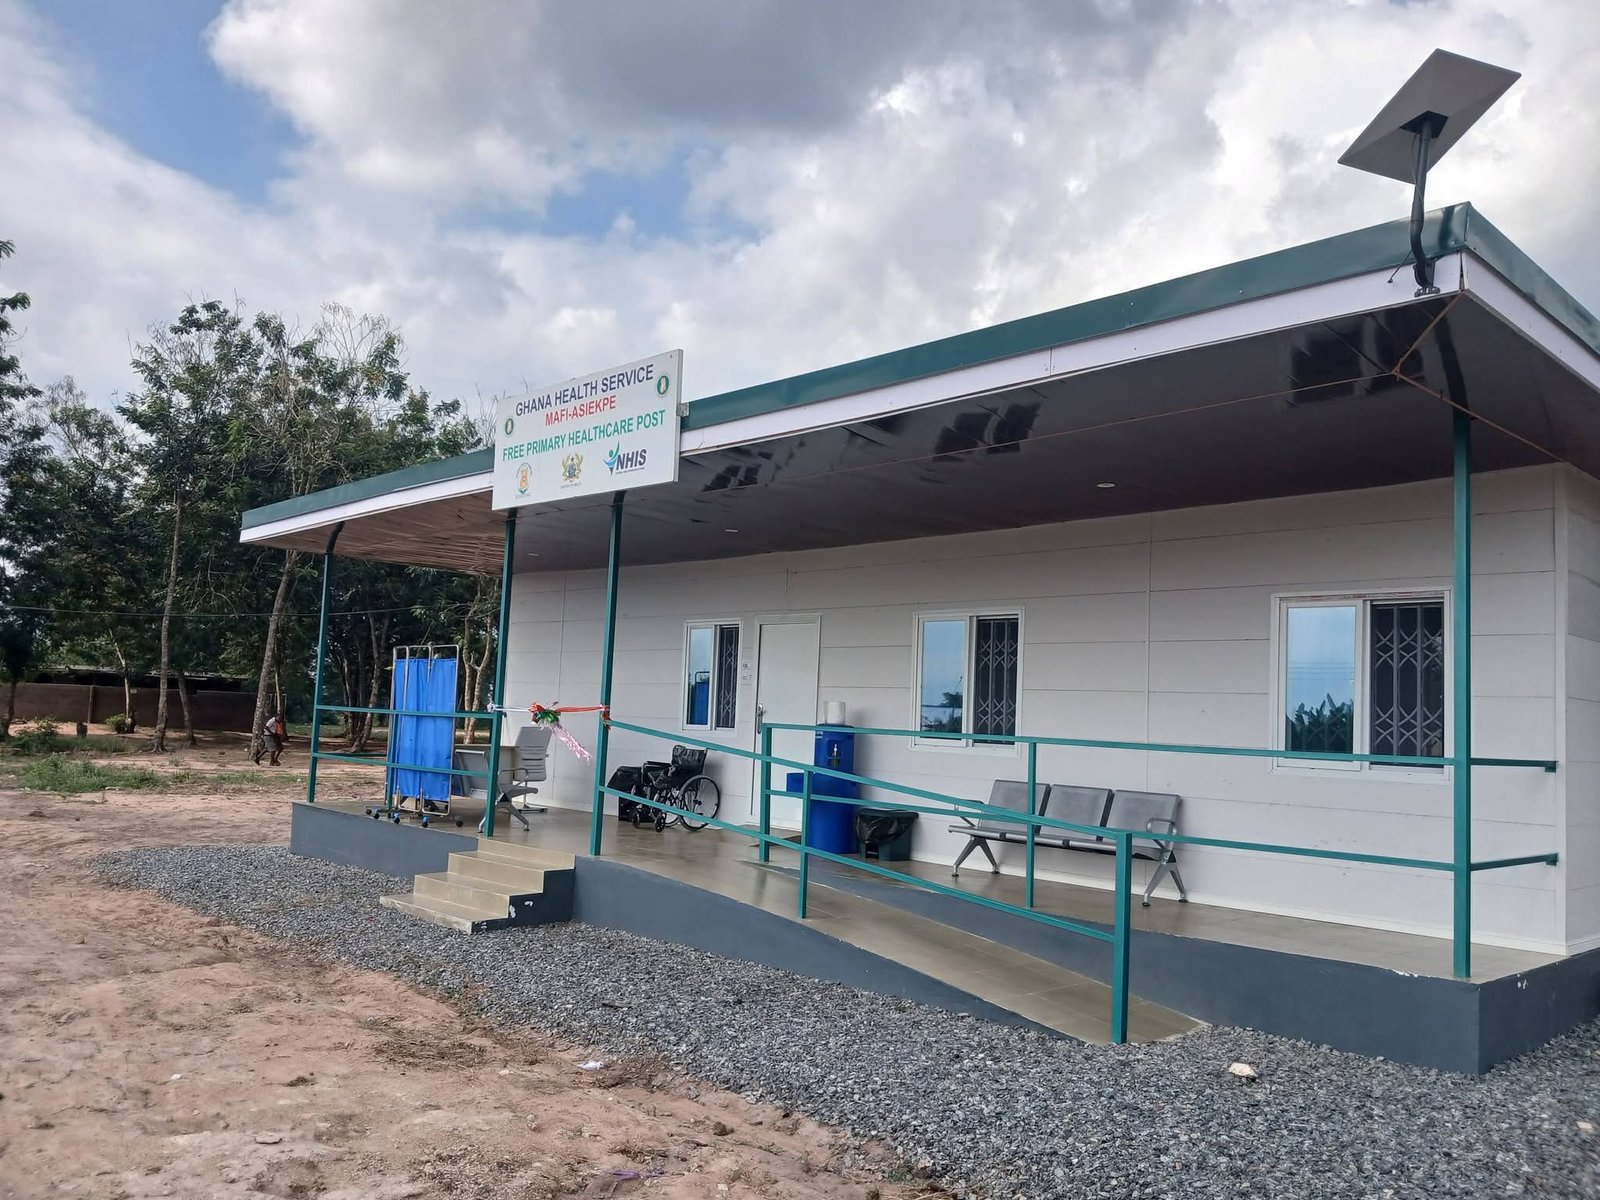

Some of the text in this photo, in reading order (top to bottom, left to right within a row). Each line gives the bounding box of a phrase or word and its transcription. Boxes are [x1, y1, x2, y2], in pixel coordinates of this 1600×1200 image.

[516, 364, 654, 416] GHANA HEALTH SERVICE
[546, 395, 616, 426] MAFI-ASIEKPE
[503, 410, 665, 461] FREE PRIMARY HEALTHCARE POST
[616, 449, 647, 470] NHIS
